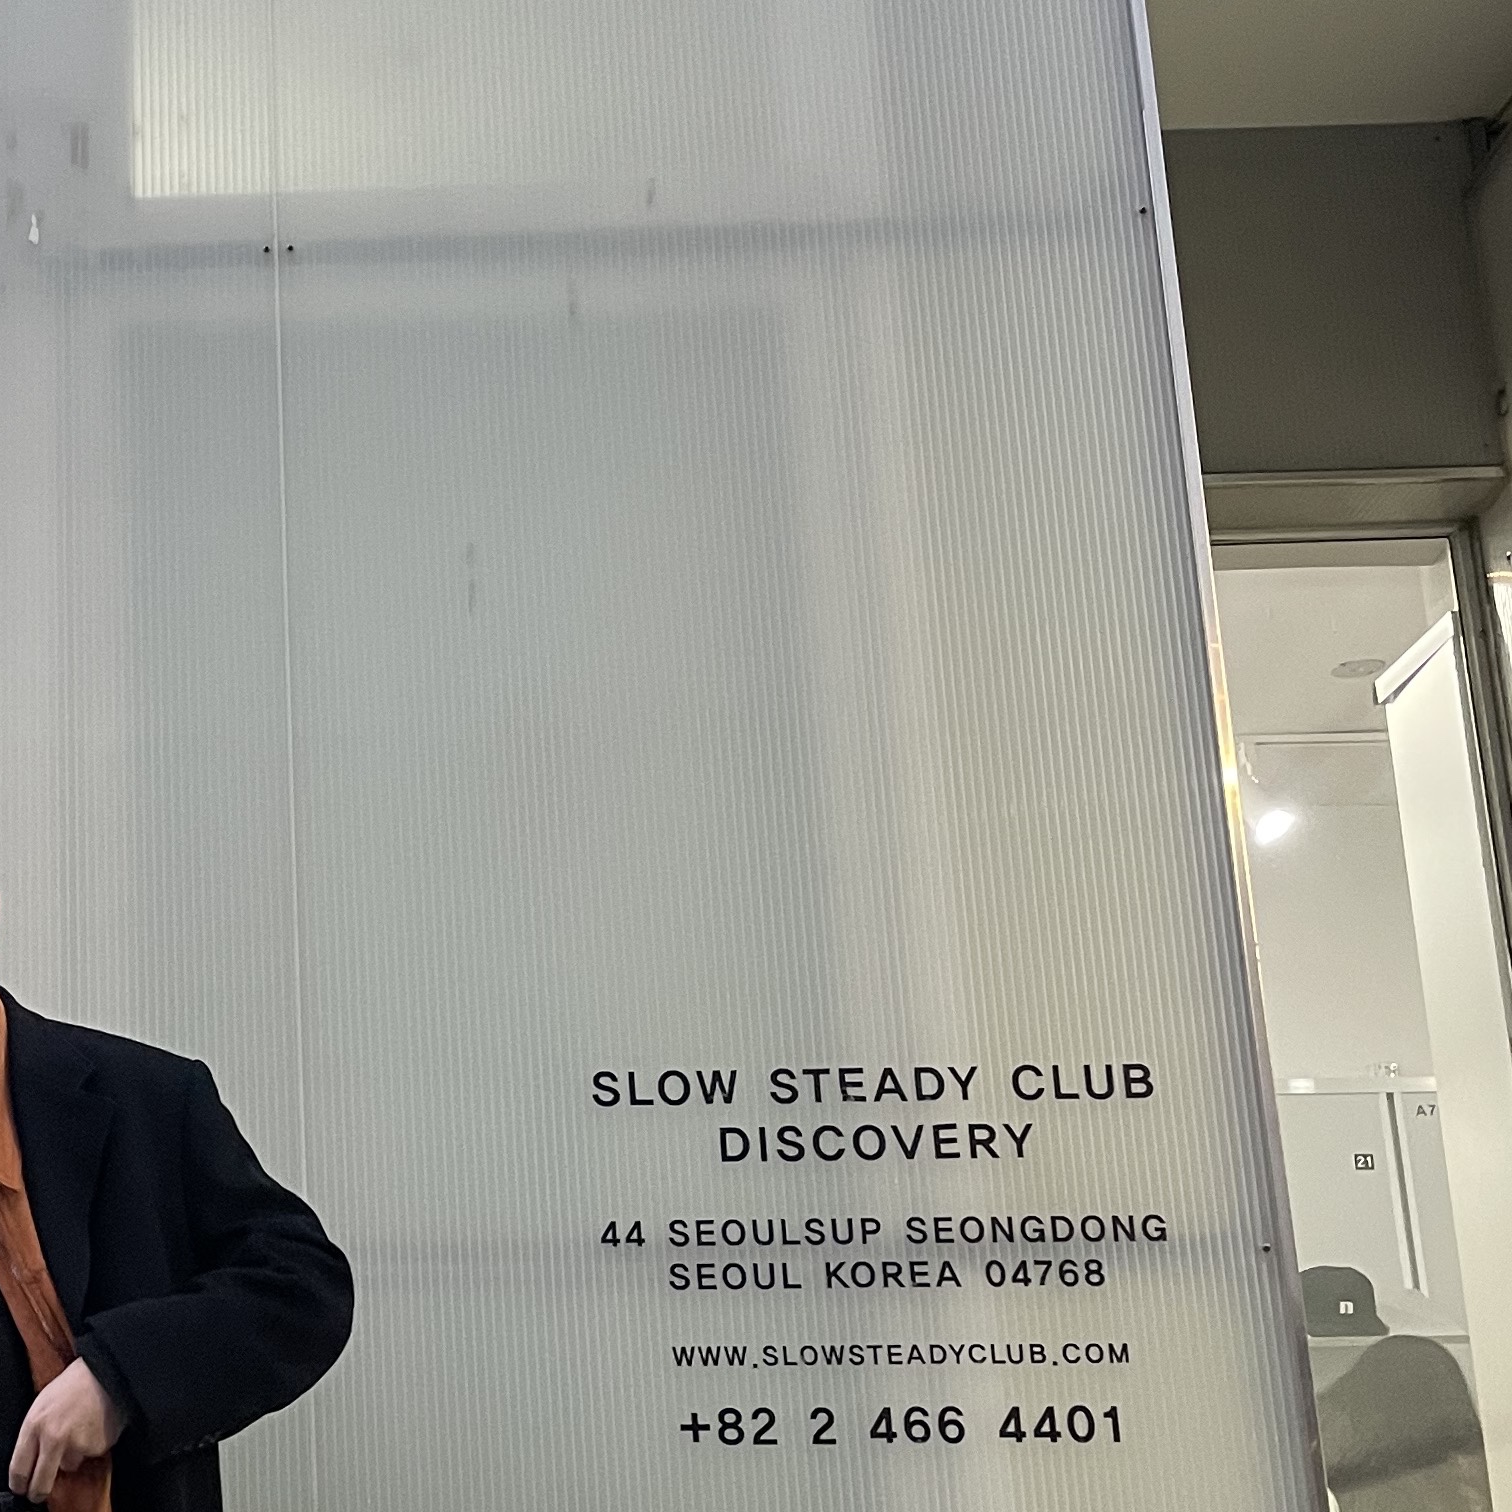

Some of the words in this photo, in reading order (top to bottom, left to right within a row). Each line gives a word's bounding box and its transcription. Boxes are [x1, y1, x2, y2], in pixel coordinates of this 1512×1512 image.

[592, 1069, 737, 1107] SLOW
[769, 1066, 978, 1105] STEADY
[1011, 1063, 1154, 1101] CLUB
[719, 1123, 1033, 1163] DISCOVERY
[1356, 1155, 1373, 1169] 21
[600, 1220, 646, 1248] 44
[668, 1217, 881, 1248] SEOULSUP
[906, 1214, 1168, 1245] SEONGDONG
[669, 1262, 803, 1291] SEOUL
[824, 1260, 962, 1289] KOREA
[985, 1258, 1106, 1288] 04768
[671, 1342, 1130, 1369] WWW.SLOWSTEADYCLUB.COM
[680, 1407, 778, 1446] +82
[809, 1406, 837, 1445] 2
[869, 1405, 965, 1444] 466
[999, 1405, 1121, 1443] 4401
